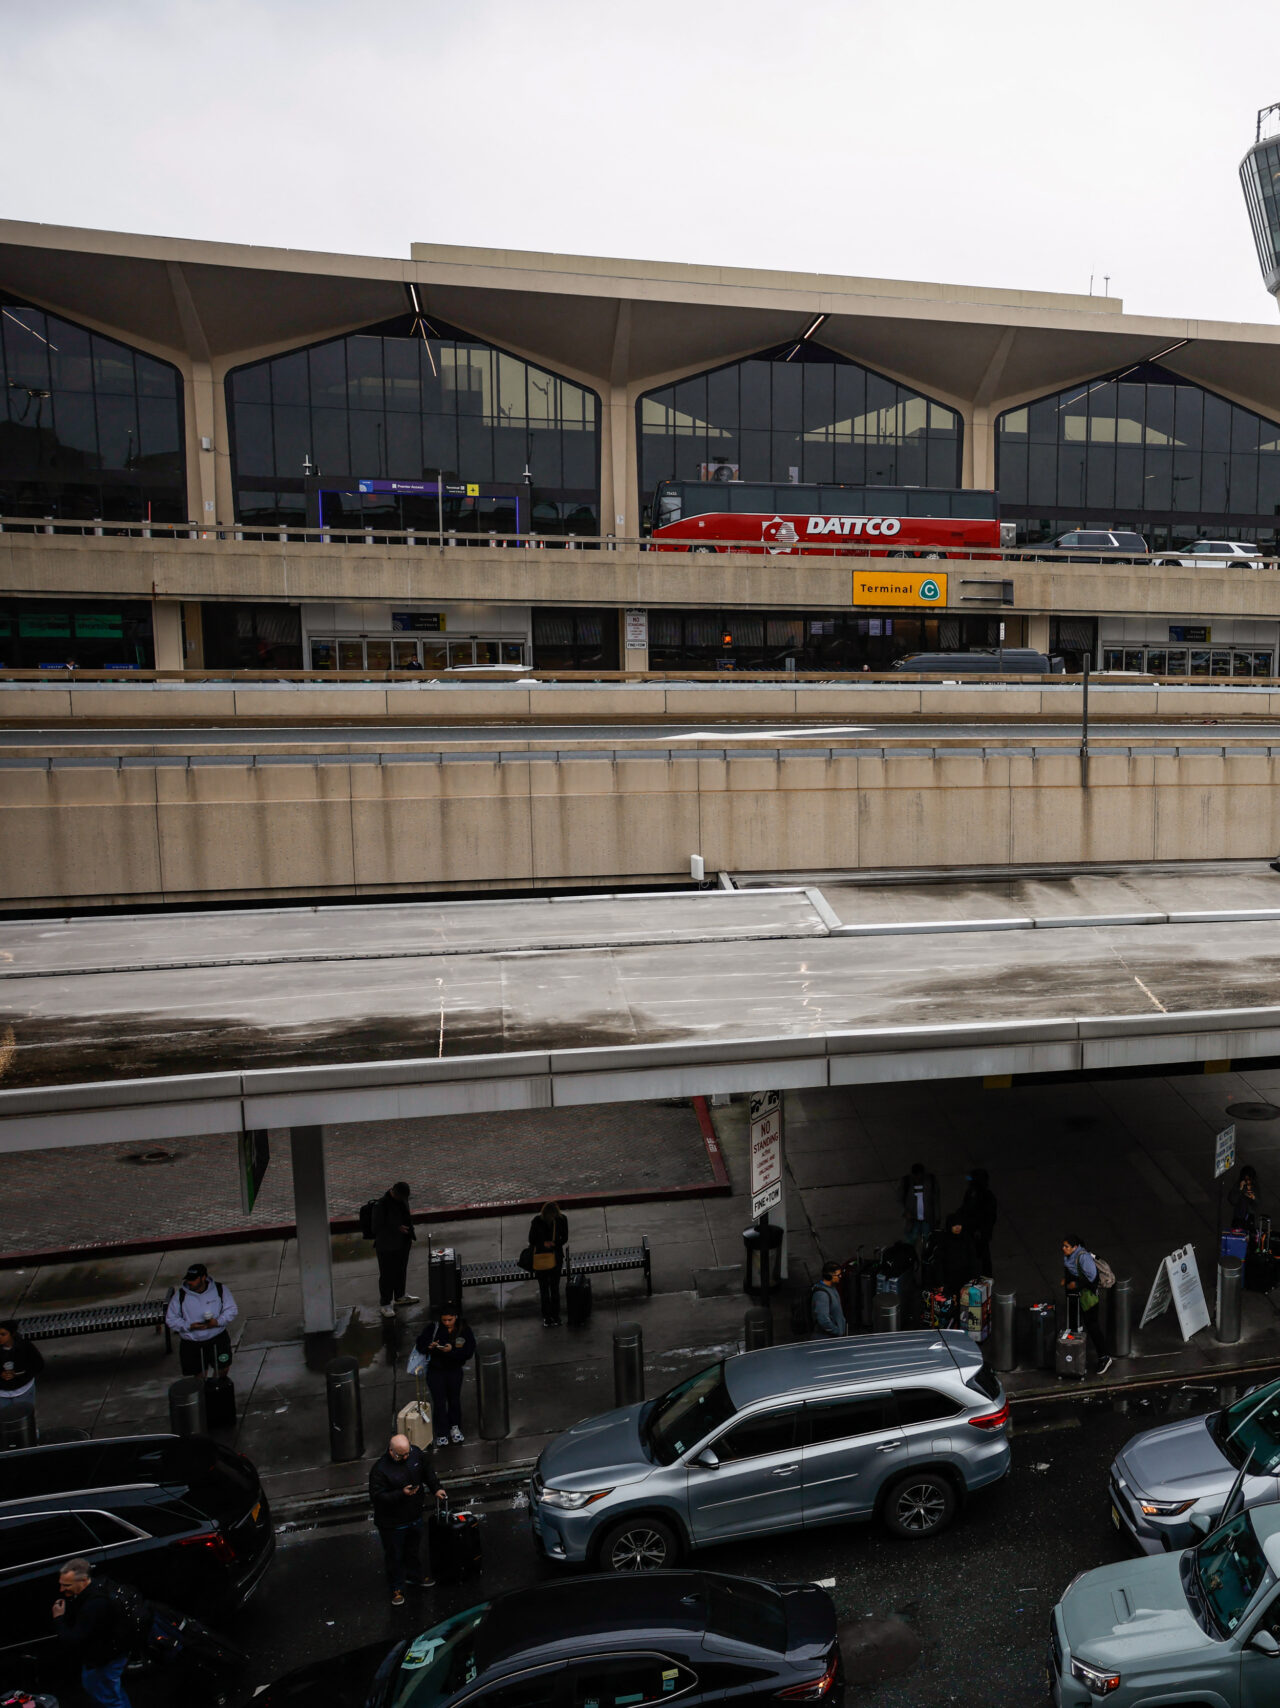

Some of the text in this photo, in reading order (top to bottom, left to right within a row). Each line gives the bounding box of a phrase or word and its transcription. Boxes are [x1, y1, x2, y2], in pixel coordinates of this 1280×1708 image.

[806, 517, 901, 536] DATTCO
[860, 584, 934, 596] Terminal C
[761, 1120, 770, 1137] NO
[754, 1132, 778, 1154] STANDING
